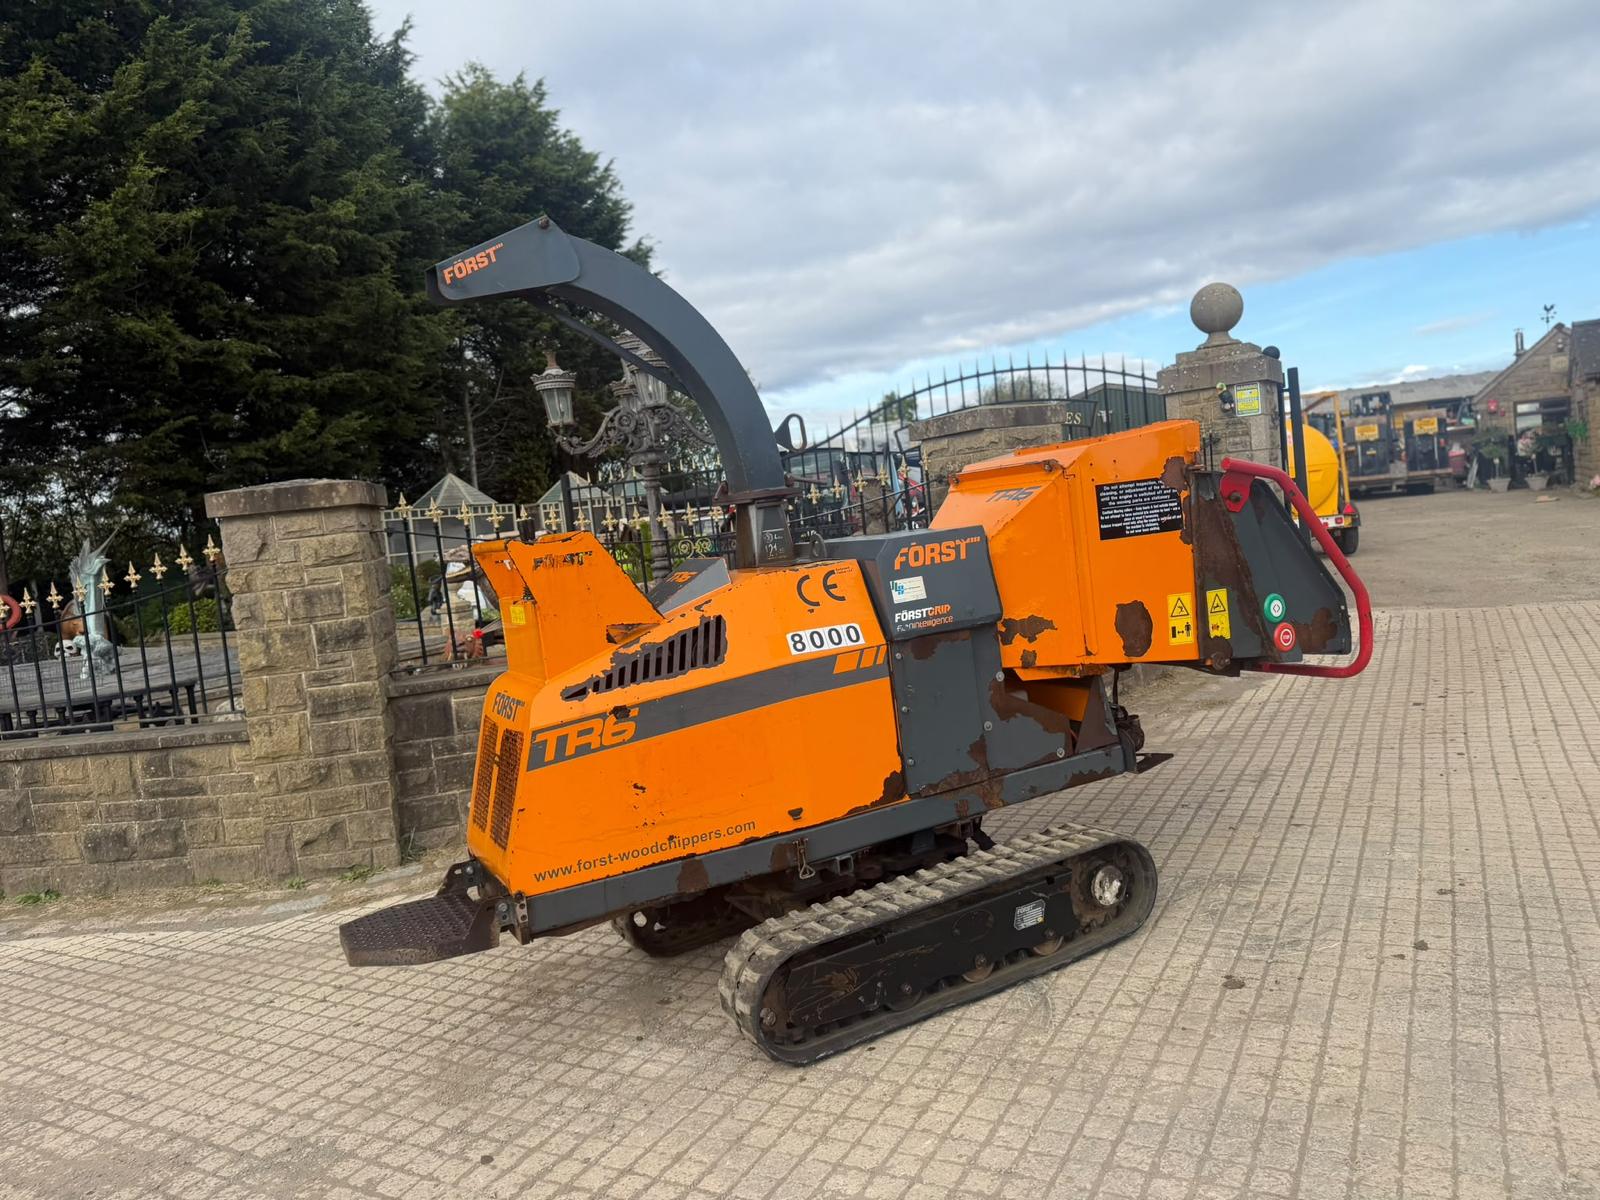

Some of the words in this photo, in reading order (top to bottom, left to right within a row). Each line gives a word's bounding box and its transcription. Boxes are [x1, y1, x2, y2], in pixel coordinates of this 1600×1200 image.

[443, 243, 500, 285] FÖRST
[894, 538, 974, 570] FÖRST
[797, 569, 846, 606] CE
[790, 625, 861, 652] 8000
[492, 690, 523, 722] FÖRST
[535, 707, 639, 763] TR6
[534, 820, 756, 883] www.forst-woodchippers.com
